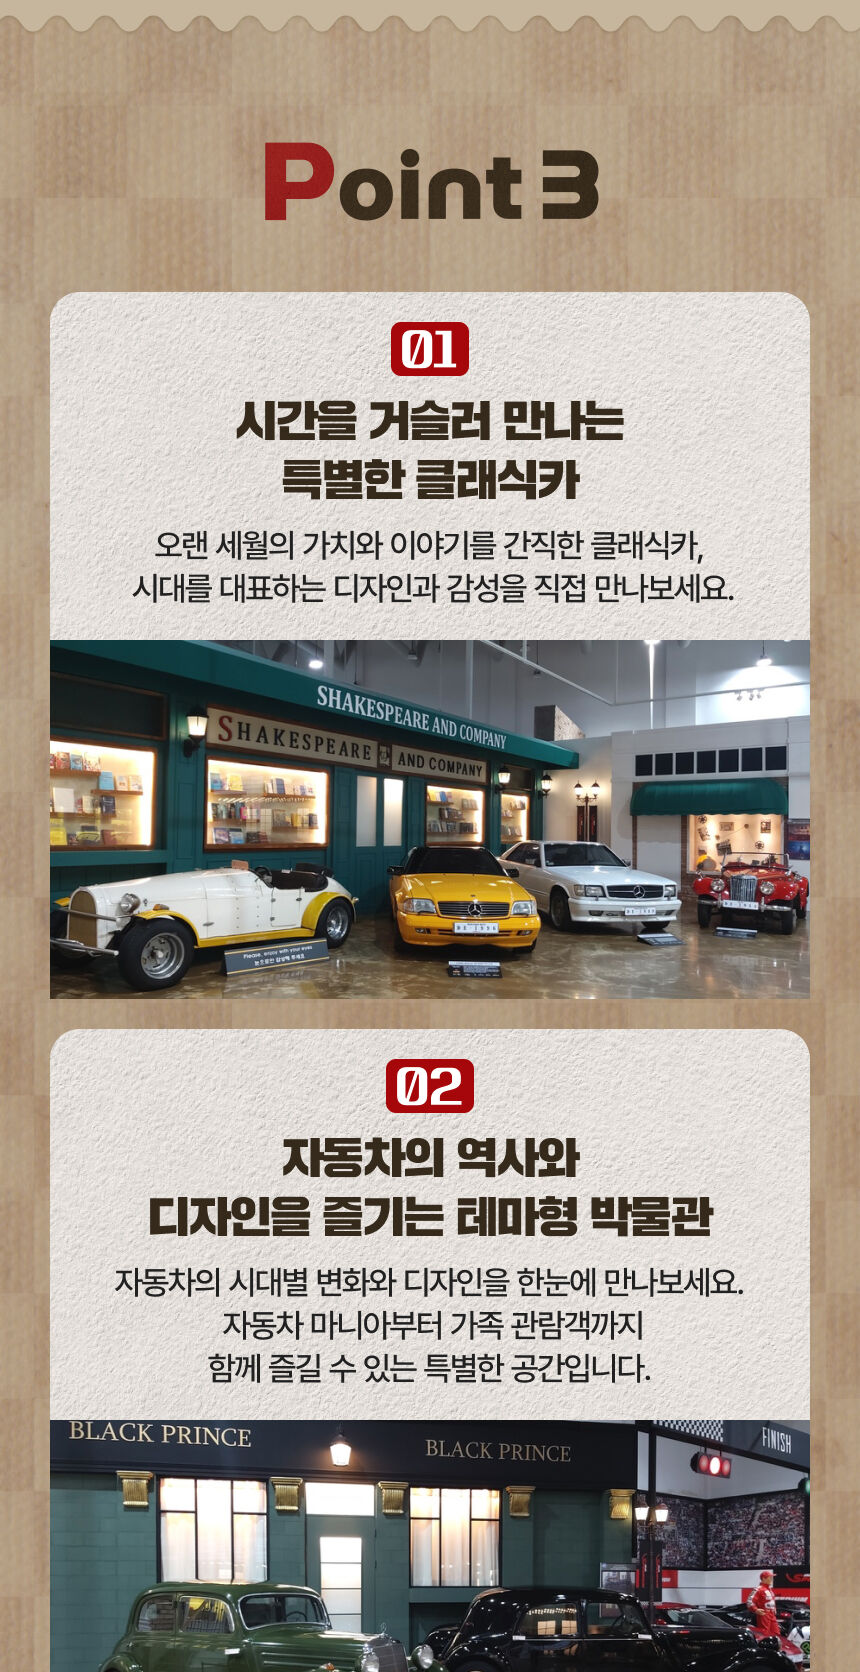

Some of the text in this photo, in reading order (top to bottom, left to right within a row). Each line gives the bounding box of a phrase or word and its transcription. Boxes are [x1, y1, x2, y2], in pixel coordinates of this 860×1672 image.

[317, 685, 507, 749] SHAKESPEARE AND COMPANY
[218, 715, 482, 777] SHAKESPEARE AND COMPANY
[69, 1421, 252, 1447] BLACK PRINCE
[762, 1426, 792, 1454] FINISH
[425, 1439, 572, 1462] BLACK PRINCE
